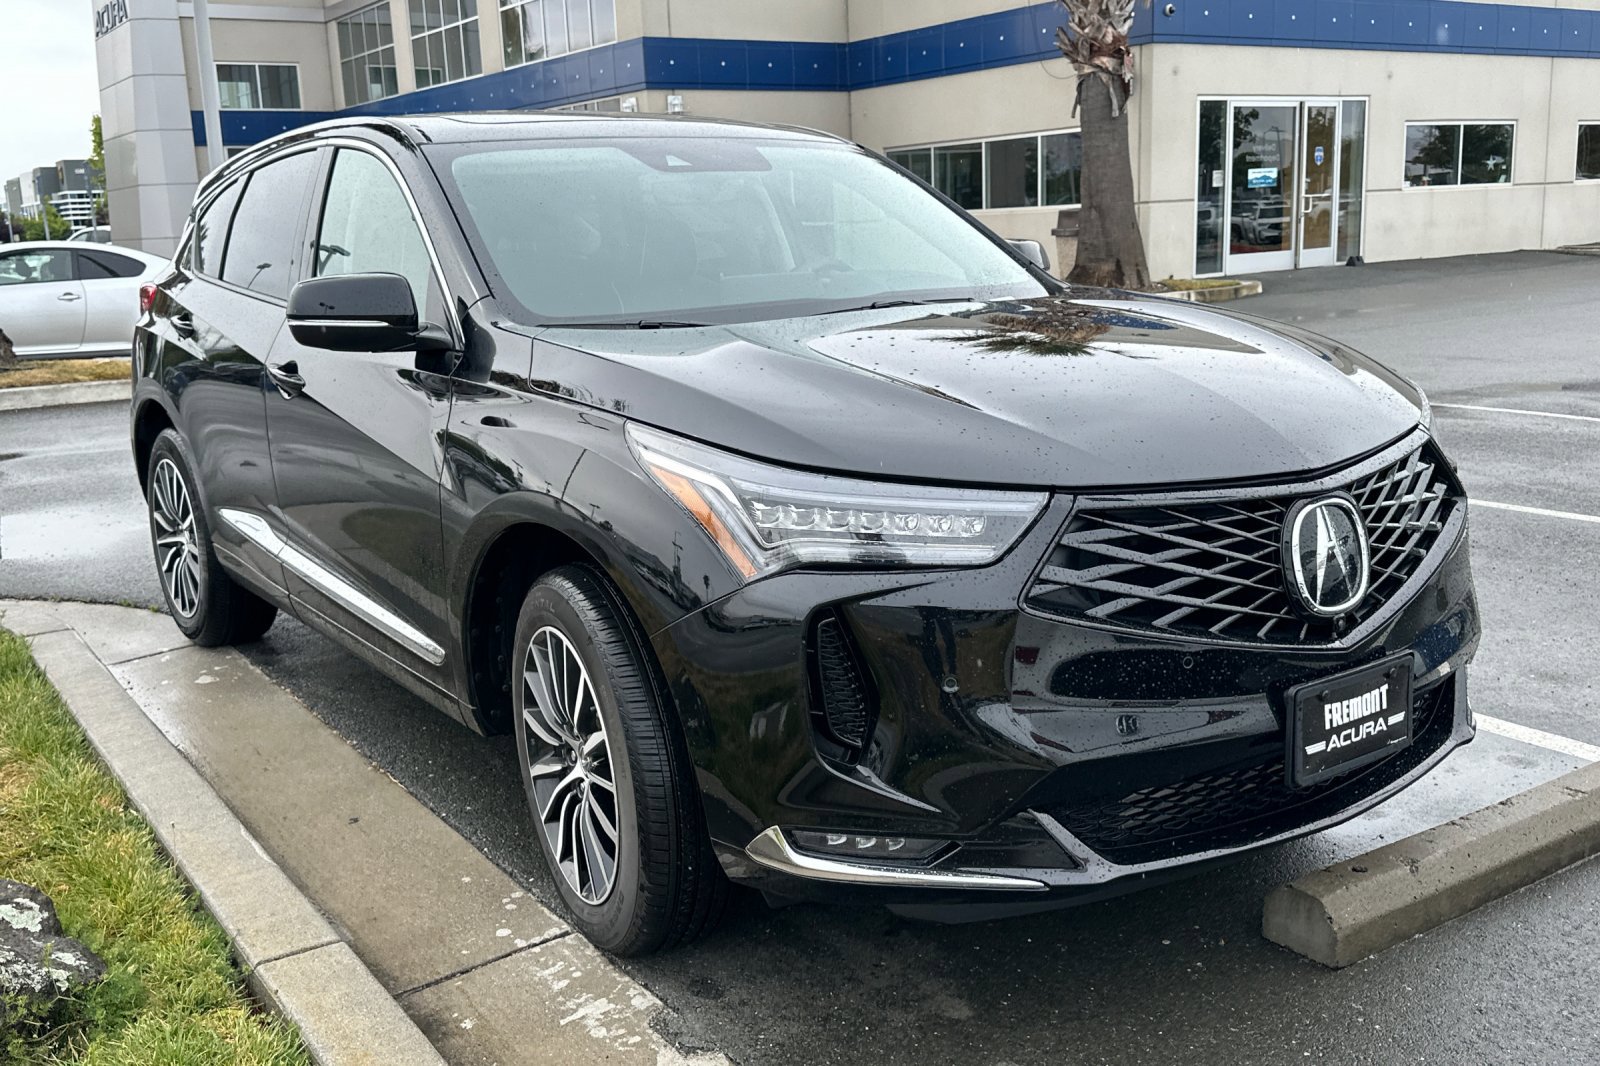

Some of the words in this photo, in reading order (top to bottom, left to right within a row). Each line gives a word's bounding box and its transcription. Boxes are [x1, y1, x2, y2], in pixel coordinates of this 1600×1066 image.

[95, 0, 128, 37] ACURA
[1324, 684, 1389, 730] FREMONT
[1327, 717, 1388, 752] ACURA
